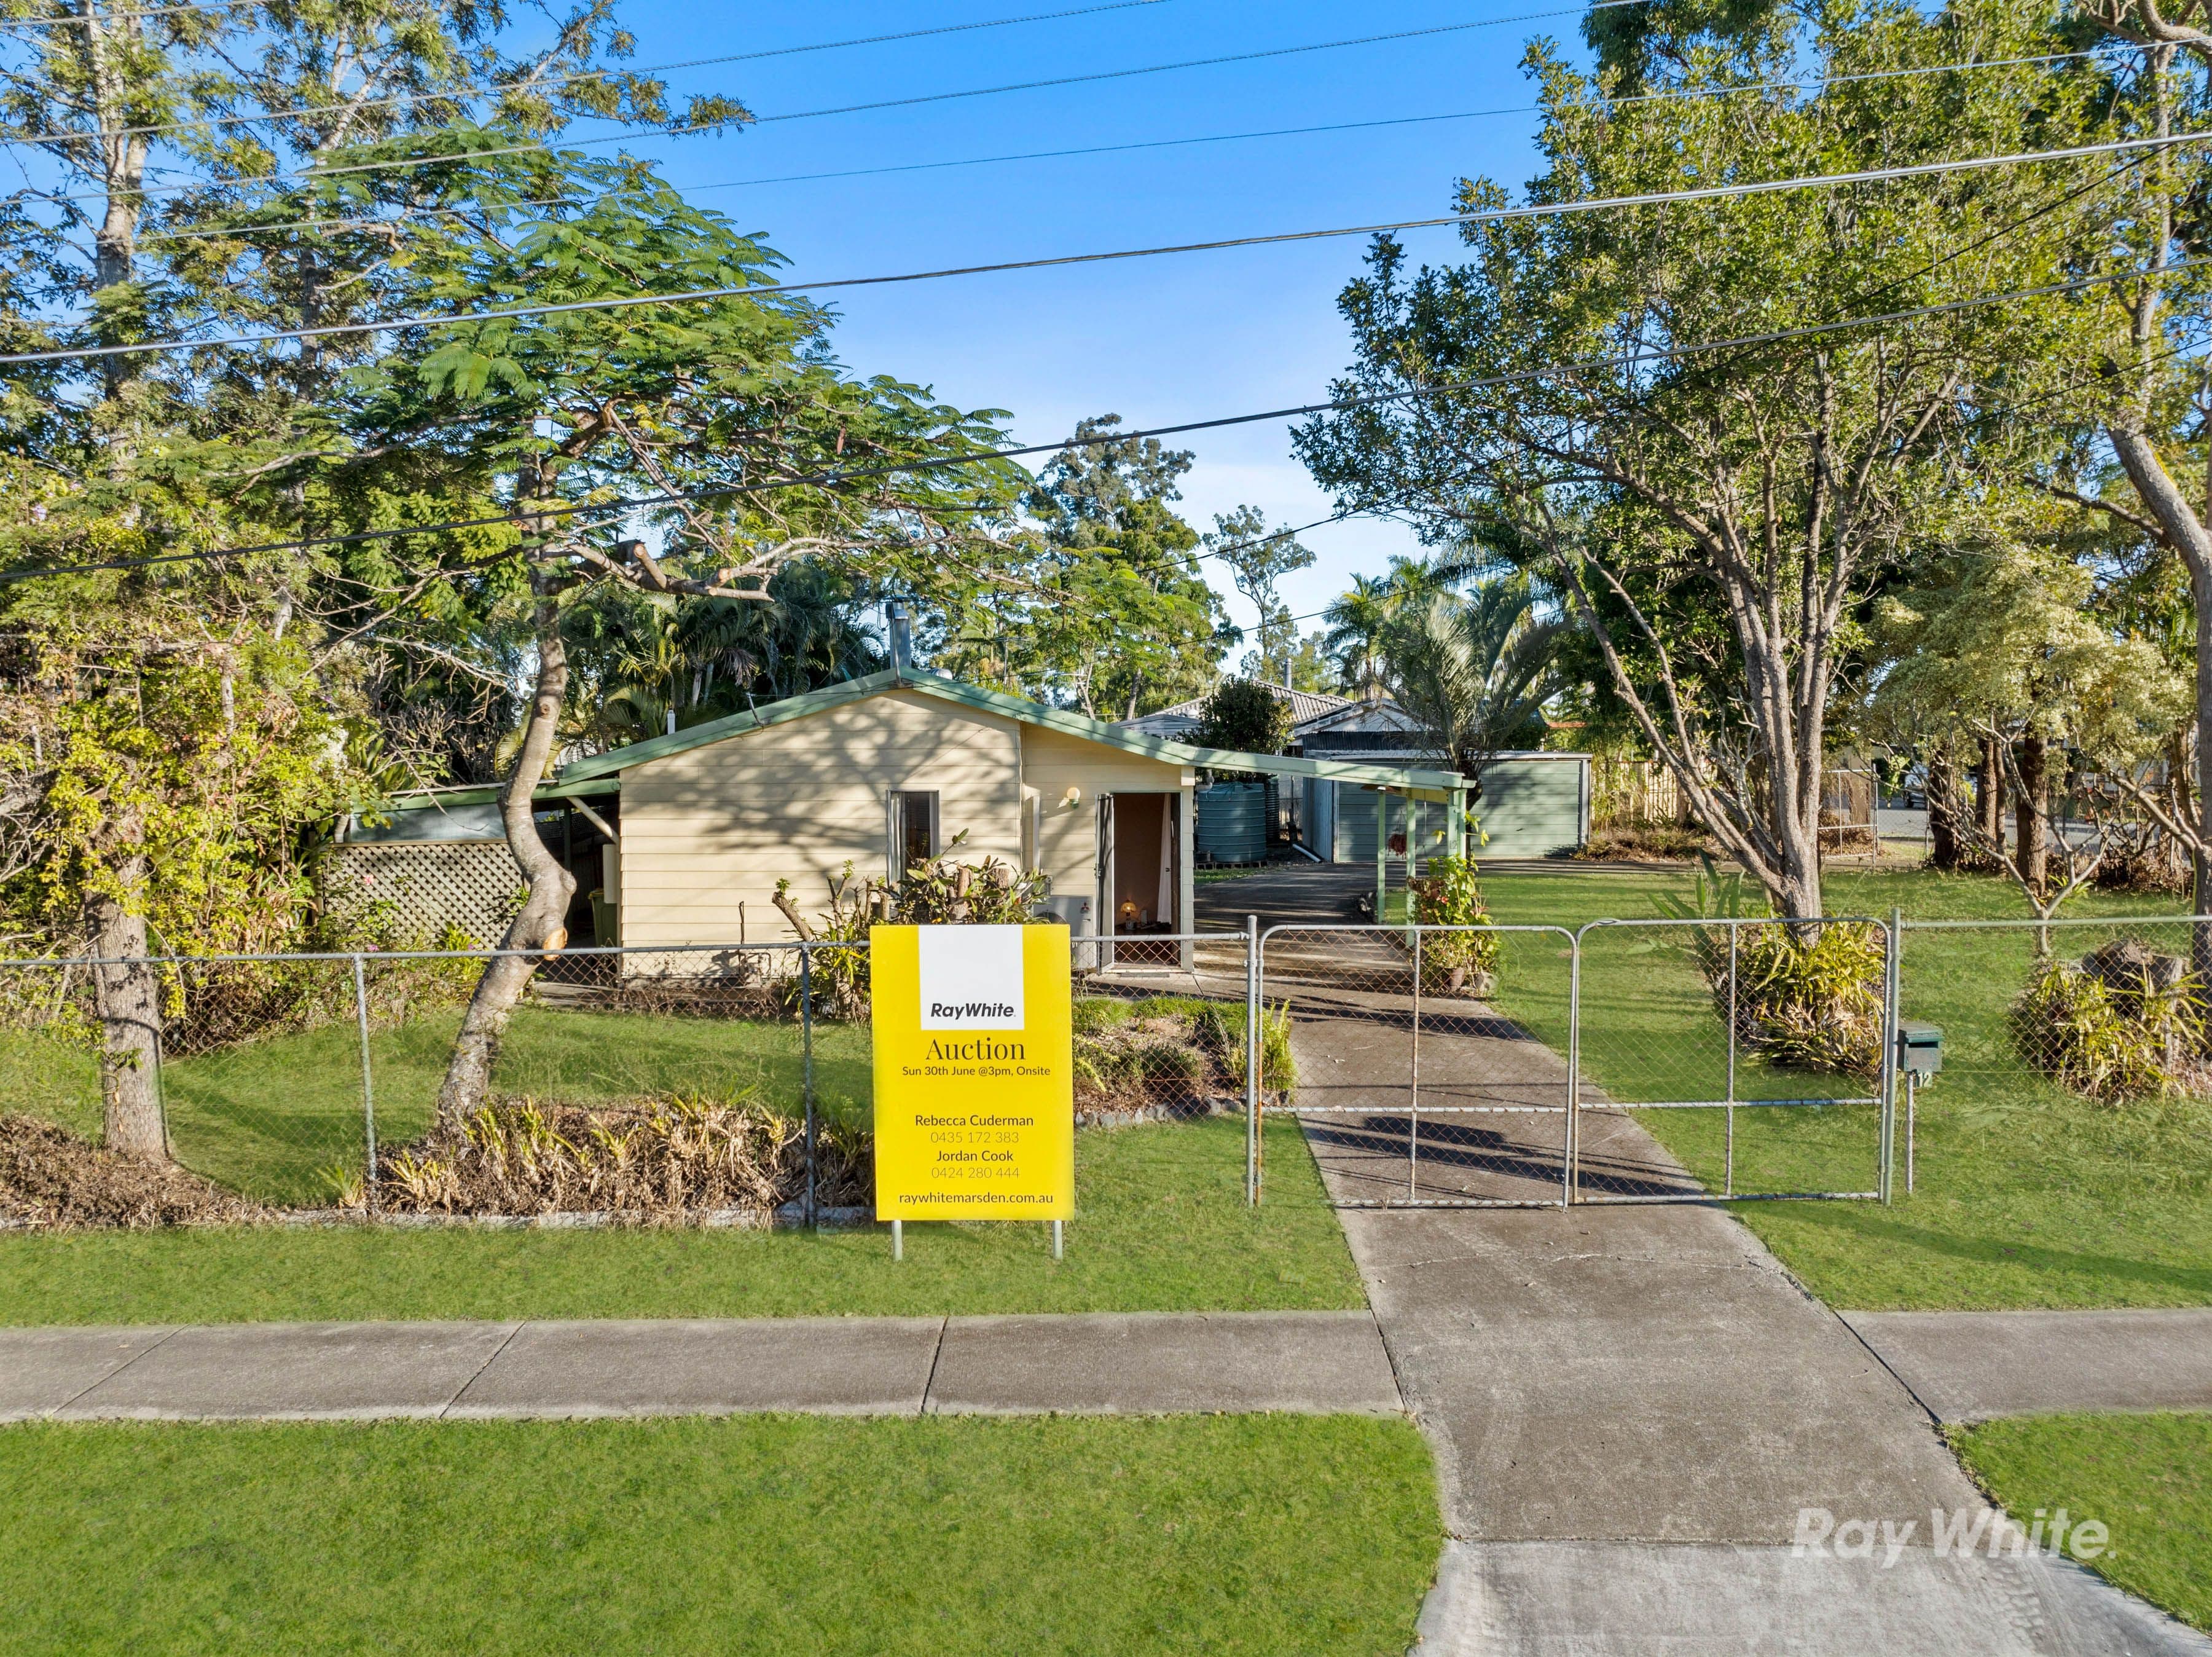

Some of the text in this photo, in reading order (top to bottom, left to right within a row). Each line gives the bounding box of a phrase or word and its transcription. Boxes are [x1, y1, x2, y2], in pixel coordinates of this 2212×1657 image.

[925, 1037, 1026, 1061] Auction
[902, 1066, 1051, 1077] Sun 30th June @3pm, Onsite
[1918, 1071, 1932, 1087] 12
[915, 1114, 1034, 1127] Rebecca Cuderman
[930, 1132, 1019, 1144] 0435 172 383
[936, 1150, 1014, 1162] Jordan Cook
[931, 1167, 1021, 1179] 0424 280 444
[899, 1191, 1053, 1205] raywhitemarsden.com.au
